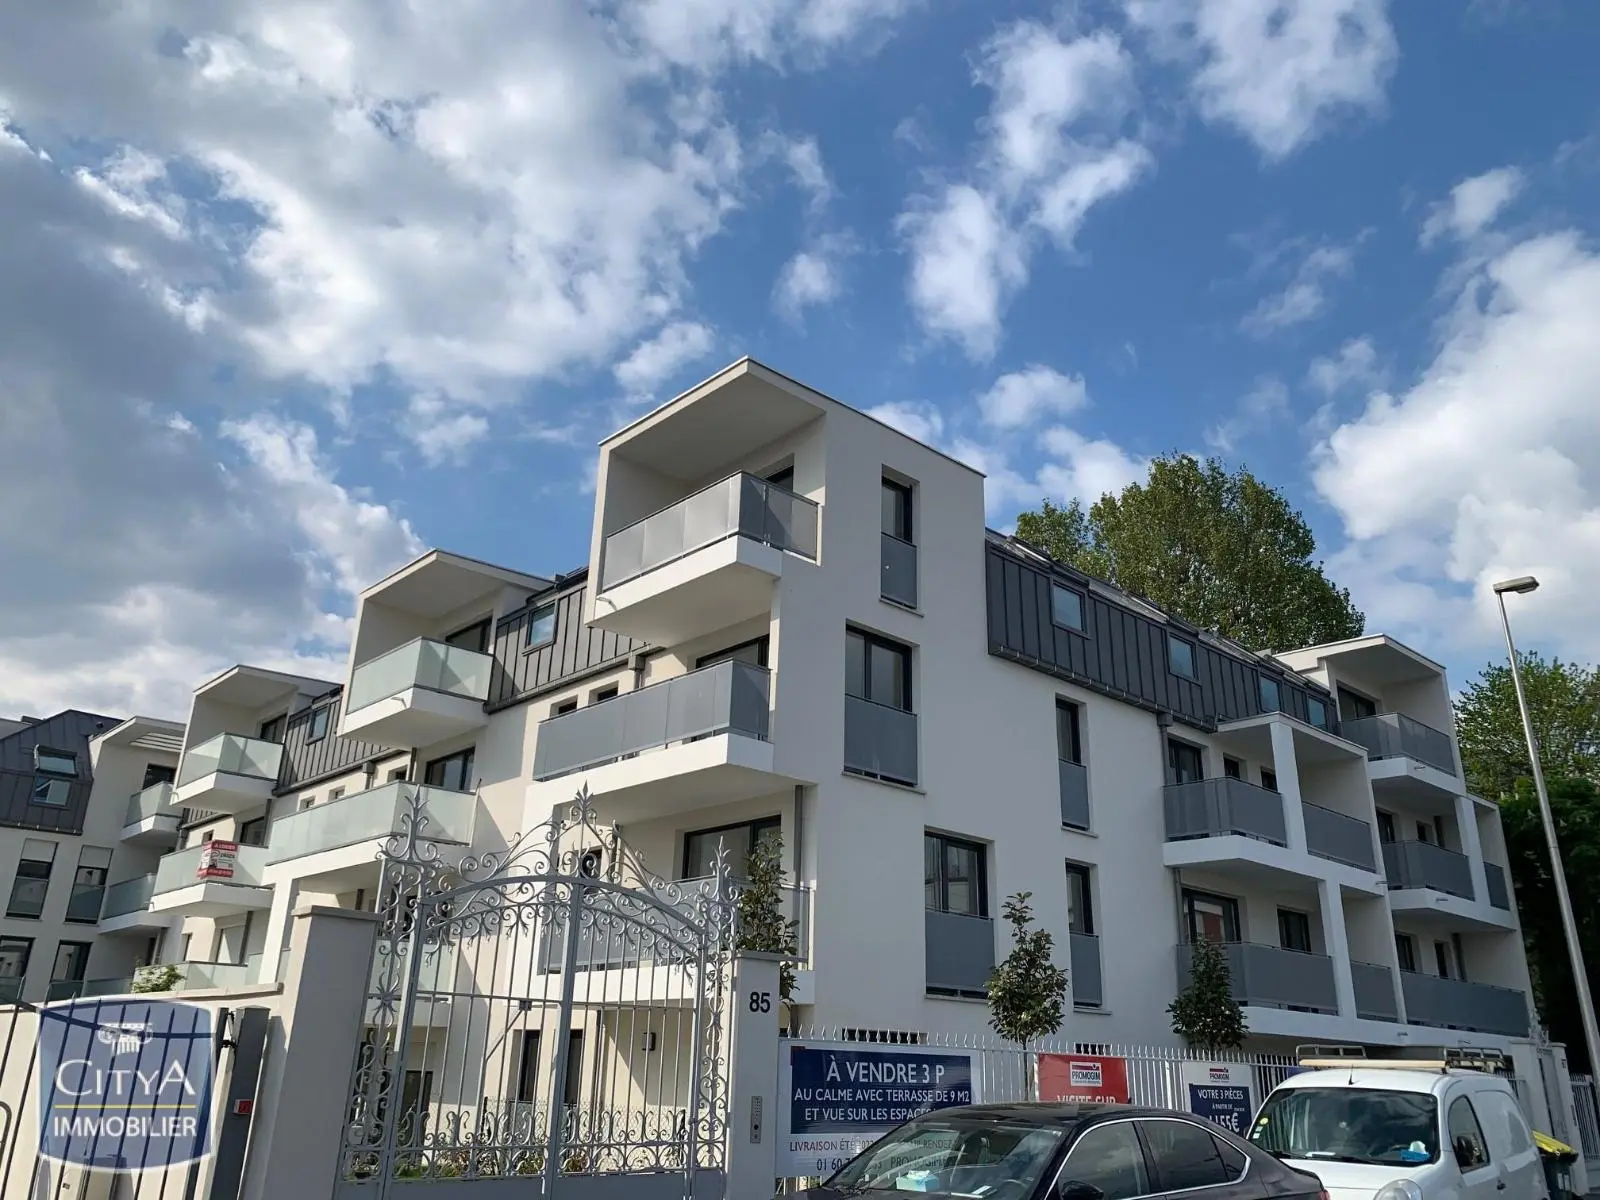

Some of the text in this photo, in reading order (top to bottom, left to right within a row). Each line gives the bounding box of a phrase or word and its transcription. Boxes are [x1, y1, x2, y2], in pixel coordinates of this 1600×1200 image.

[749, 992, 771, 1013] 85
[826, 1054, 945, 1084] À VENDRE 3 P
[1072, 1070, 1100, 1080] PROMOGIM
[794, 1088, 970, 1103] AU CALME AVEC TERRASSE DE 9 M2
[1198, 1088, 1244, 1100] VOTRE 3 PIÈCES
[805, 1108, 819, 1120] ET
[822, 1108, 845, 1120] VUE
[848, 1108, 868, 1120] SUR
[871, 1108, 888, 1120] LES
[790, 1140, 838, 1152] LIVRAISON
[840, 1138, 854, 1151] ÉTÉ
[816, 1158, 827, 1171] 01
[831, 1158, 843, 1170] 60
